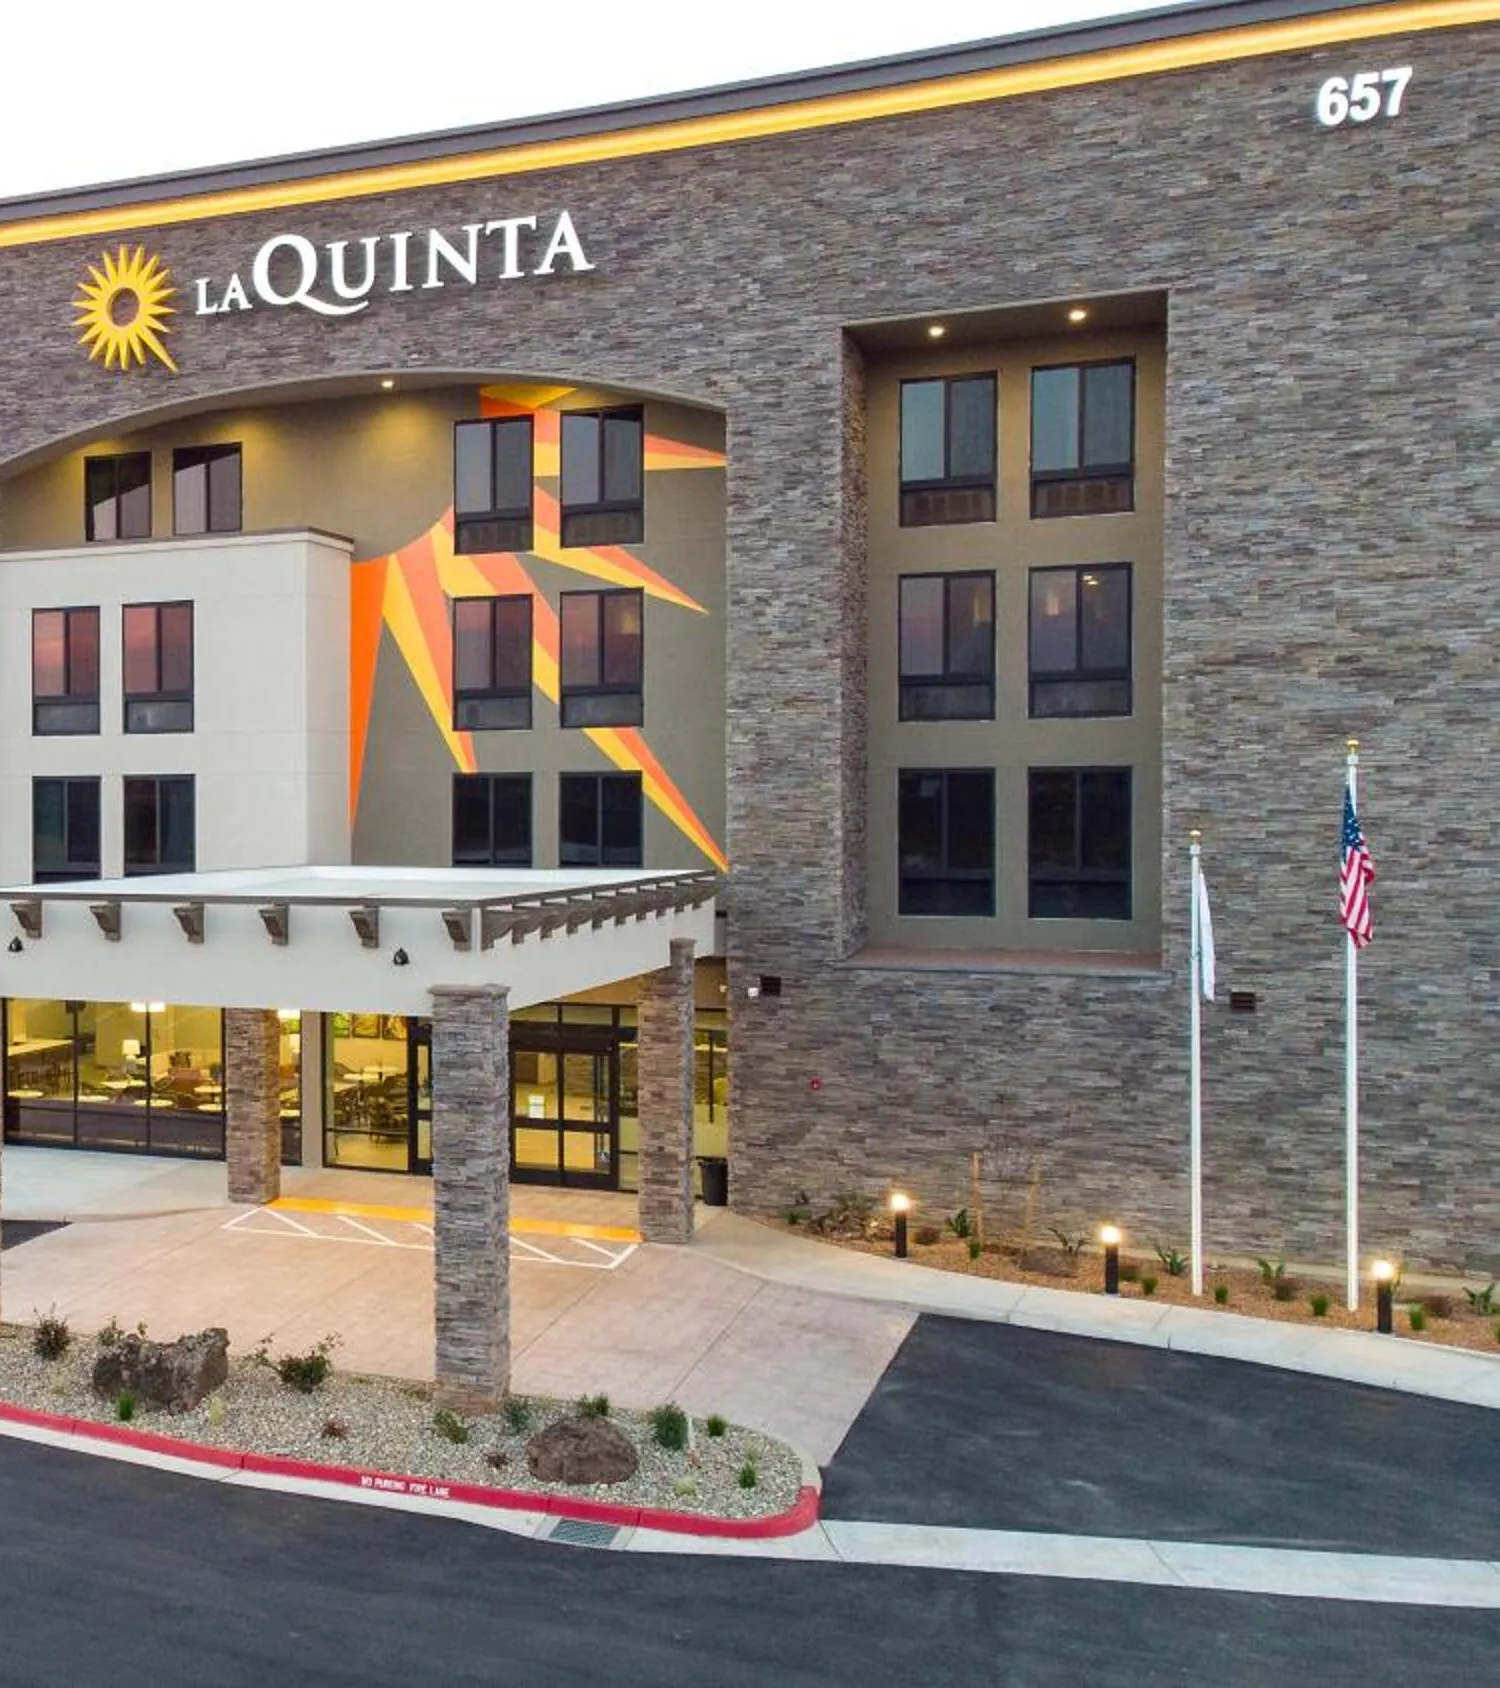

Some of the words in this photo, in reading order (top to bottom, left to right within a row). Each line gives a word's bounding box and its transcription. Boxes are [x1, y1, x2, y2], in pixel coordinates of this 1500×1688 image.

[1316, 66, 1413, 126] 657
[195, 272, 252, 315] LA
[252, 210, 596, 316] QUINTA
